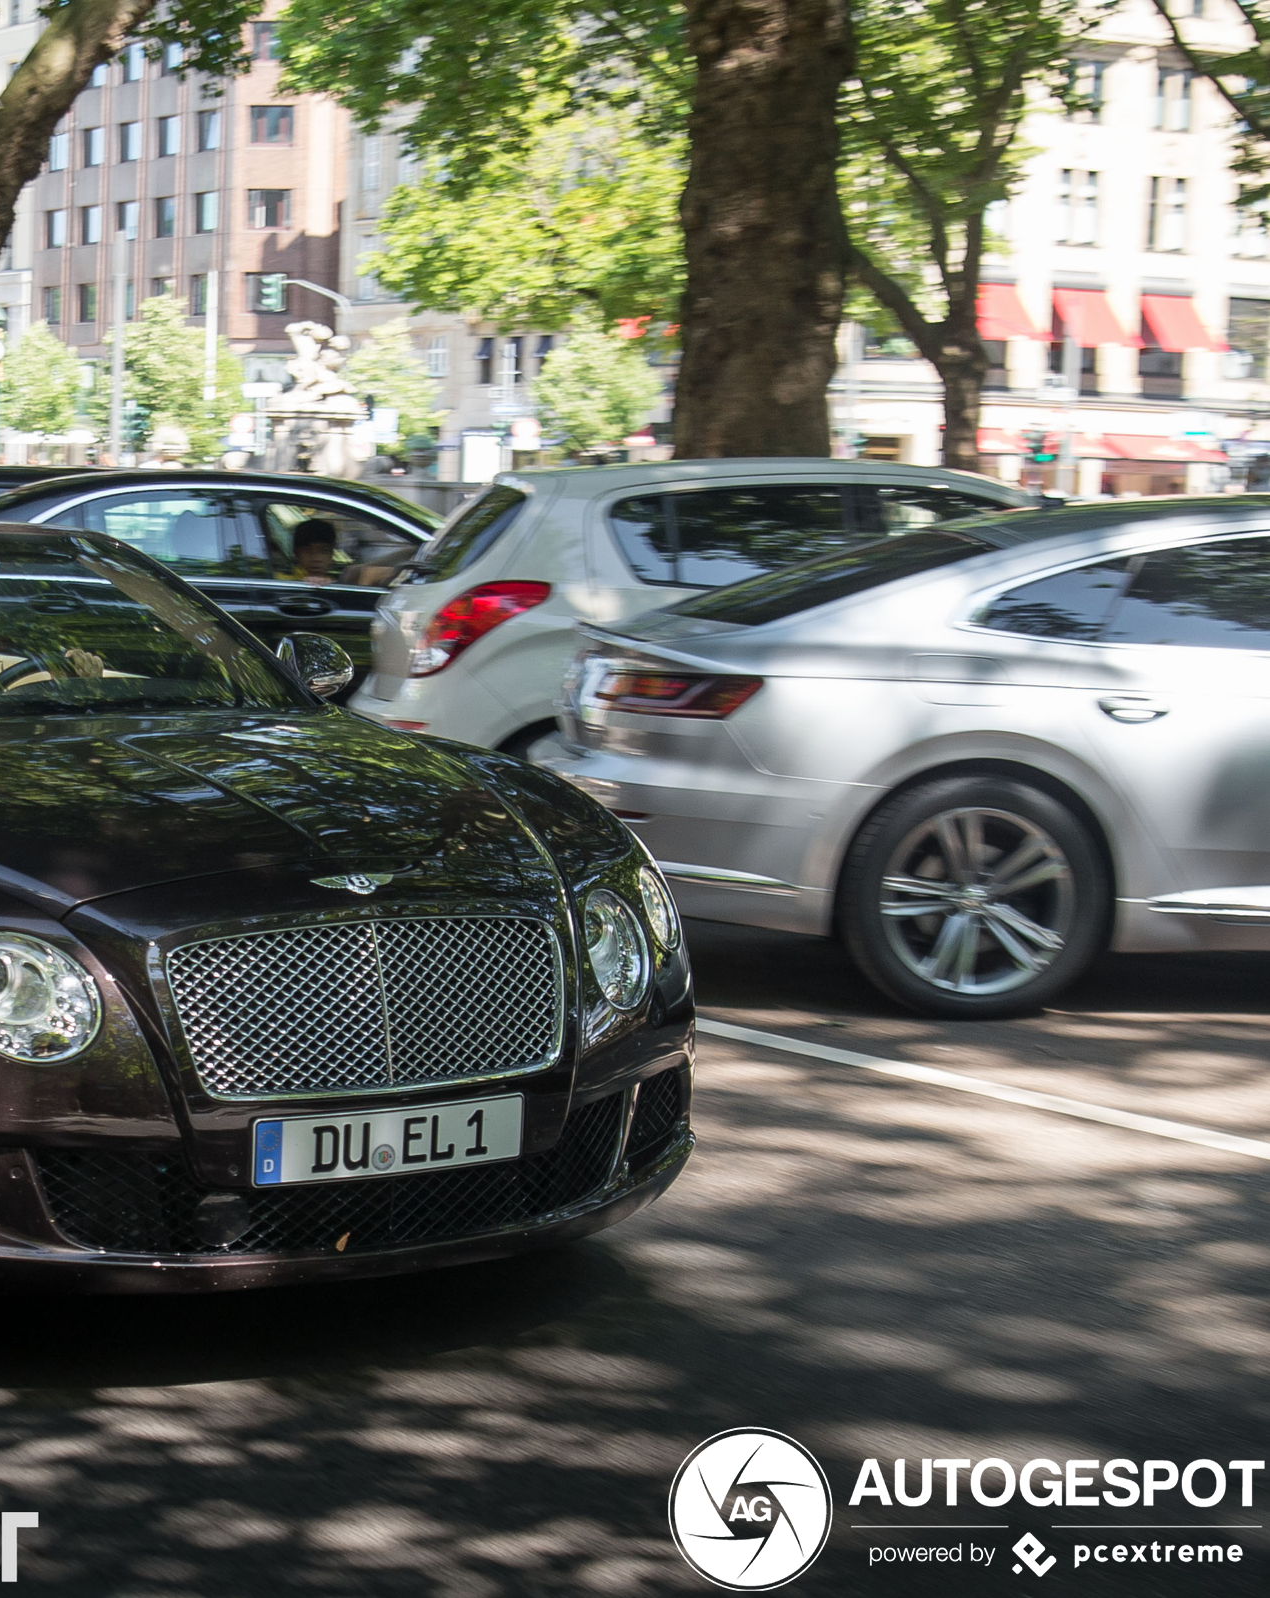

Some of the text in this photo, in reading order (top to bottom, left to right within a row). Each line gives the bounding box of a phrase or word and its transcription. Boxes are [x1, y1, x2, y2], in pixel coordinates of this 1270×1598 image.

[311, 1108, 489, 1174] DU EL 1
[263, 1158, 275, 1173] D
